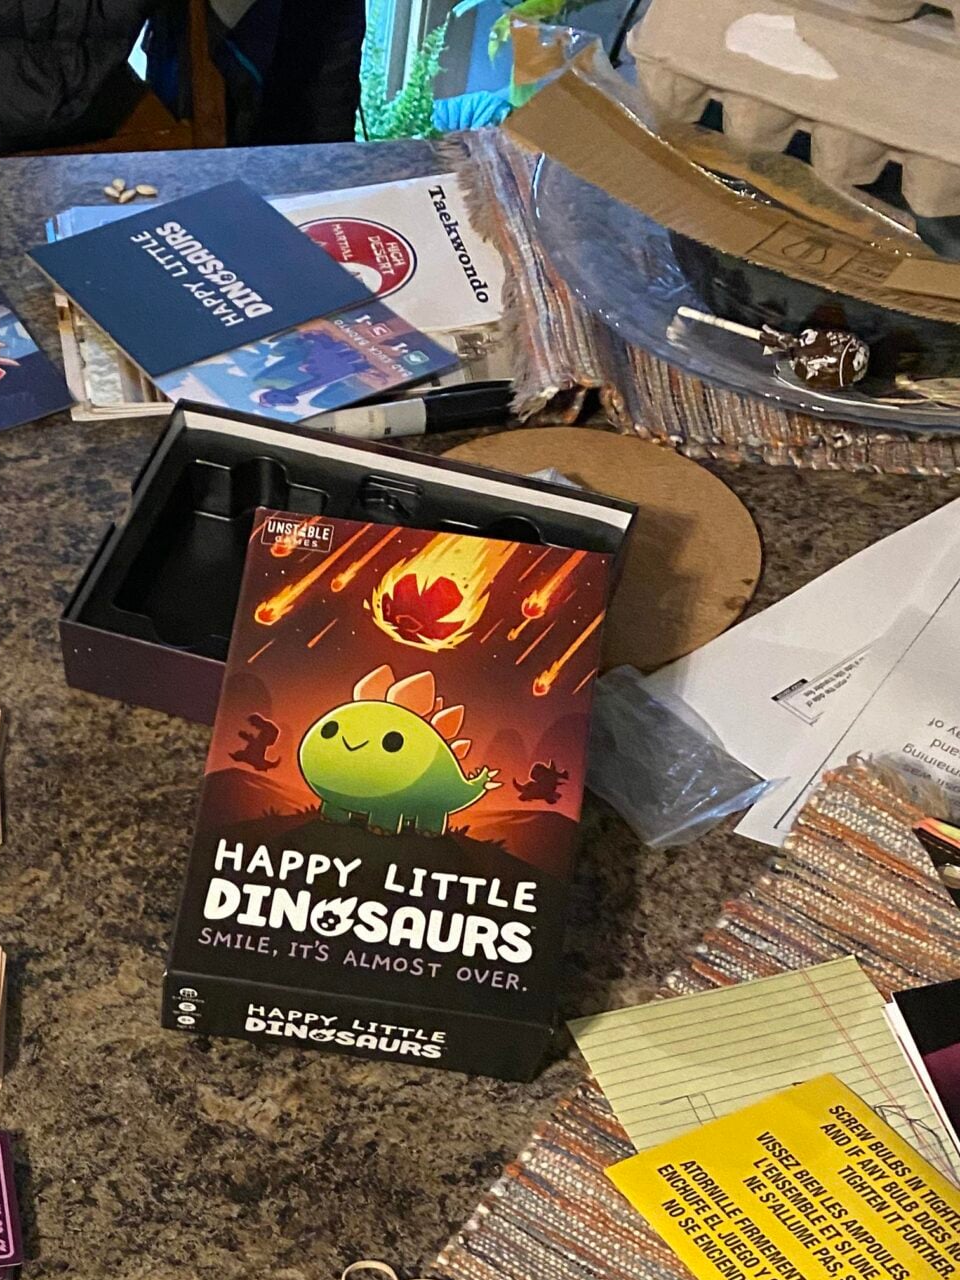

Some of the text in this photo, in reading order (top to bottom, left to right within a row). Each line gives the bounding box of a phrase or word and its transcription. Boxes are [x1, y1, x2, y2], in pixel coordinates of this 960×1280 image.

[131, 230, 244, 327] HAPPY LITTLE
[154, 220, 274, 319] DINOSAURS
[332, 223, 354, 261] MARTIAL
[368, 235, 395, 275] DESERT
[386, 241, 406, 267] HIGH
[428, 185, 490, 304] Taekwondo
[275, 534, 318, 549] GAMES
[902, 742, 960, 778] maining
[213, 837, 539, 914] HAPPY LITTLE
[198, 926, 529, 993] SMILE, IT'S ALMOST OVER.
[202, 878, 534, 965] DINOSAURS
[244, 1016, 443, 1059] DINOSAURS
[248, 1003, 447, 1044] HAPPY LITTLE
[680, 1161, 742, 1218] ATORNILLE
[757, 1132, 800, 1170] VISSEZ
[794, 1170, 827, 1197] BIEN
[820, 1197, 848, 1219] LES
[820, 1124, 851, 1146] AND
[845, 1146, 865, 1156] IF
[857, 1159, 890, 1180] ANY
[882, 1182, 919, 1212] BULB
[912, 1212, 951, 1243] DOES
[830, 1106, 960, 1233] SCREW BULBS IN TIGHTL
[658, 1164, 711, 1215] ENCHUFE
[704, 1214, 723, 1230] EL
[718, 1232, 760, 1268] JUEGO
[754, 1268, 770, 1277] Y
[662, 1199, 685, 1217] NO
[679, 1218, 701, 1235] SE
[743, 1176, 767, 1194] NE
[760, 1193, 820, 1248] S'ALLUME
[813, 1248, 843, 1277] PAS,
[754, 1158, 826, 1226] L'ENSEMBLE
[819, 1224, 842, 1240] ET
[835, 1241, 856, 1255] SI
[849, 1254, 880, 1280] UNE
[838, 1165, 955, 1280] TIGHTEN IT FURTHER.
